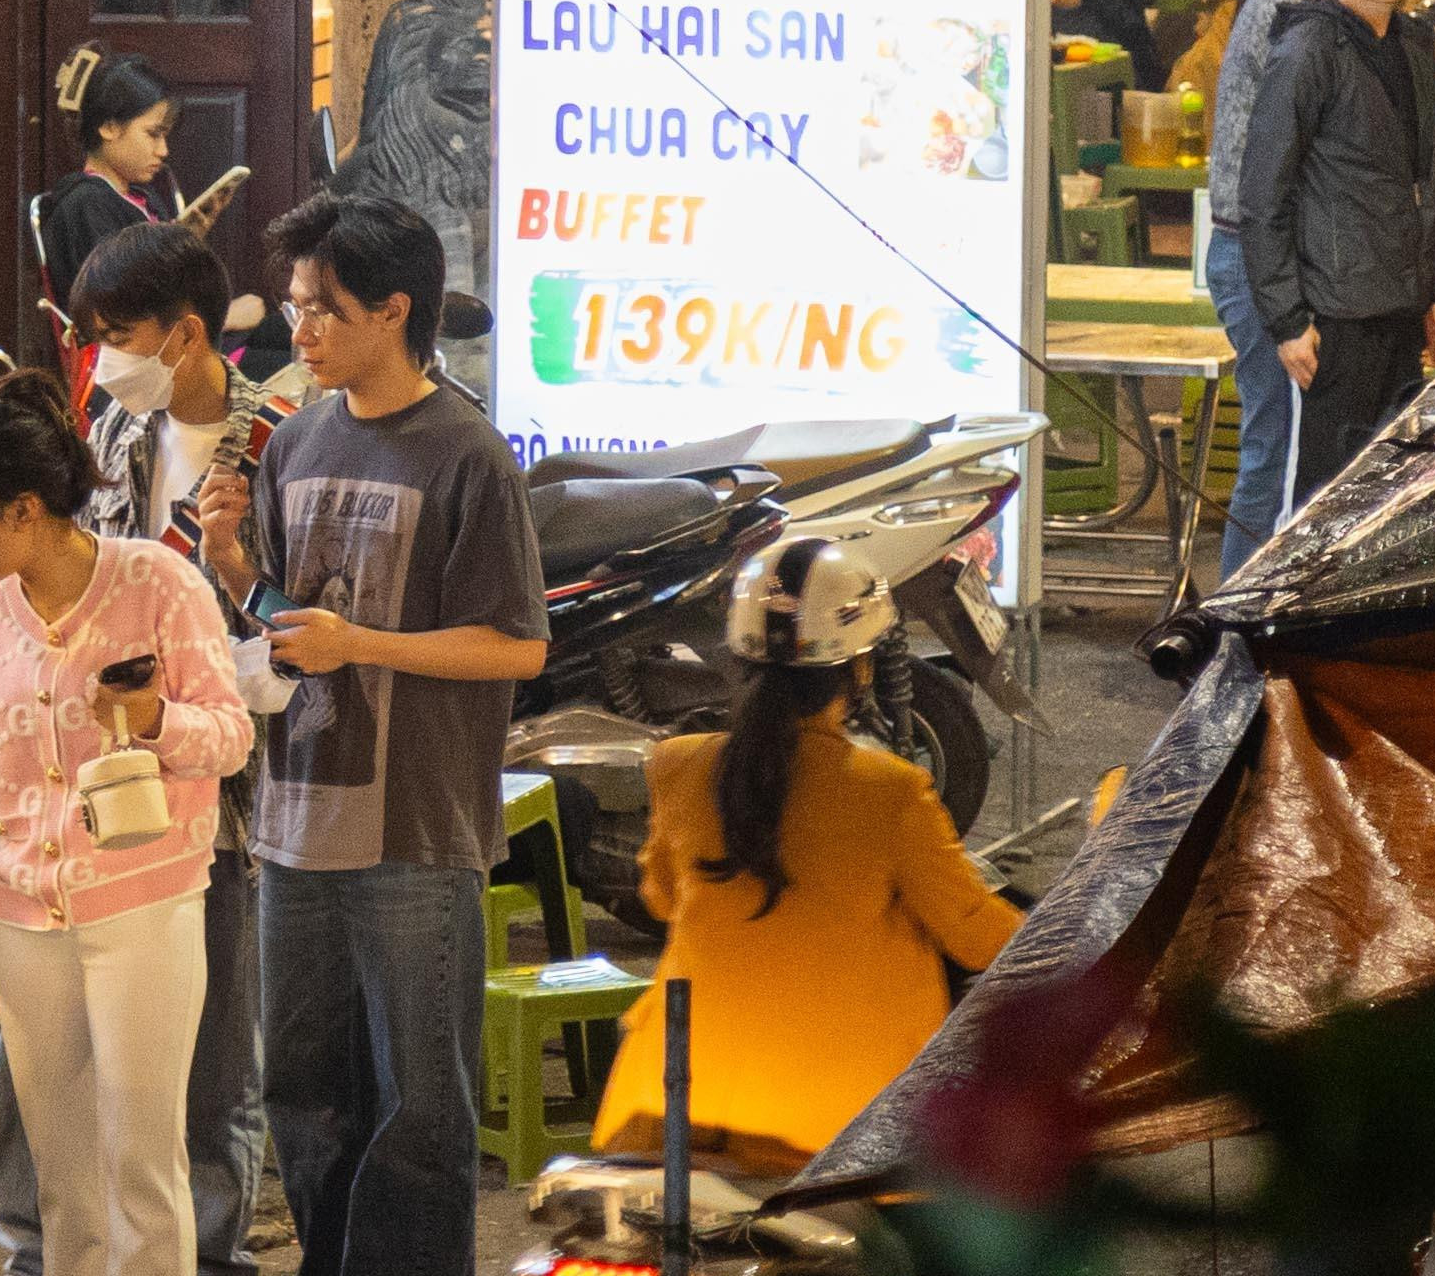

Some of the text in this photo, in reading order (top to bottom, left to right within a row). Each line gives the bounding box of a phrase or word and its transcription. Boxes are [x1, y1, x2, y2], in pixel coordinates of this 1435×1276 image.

[554, 102, 810, 164] CHUA CAY
[517, 188, 707, 246] BUFFET
[582, 293, 908, 374] 139K/NG
